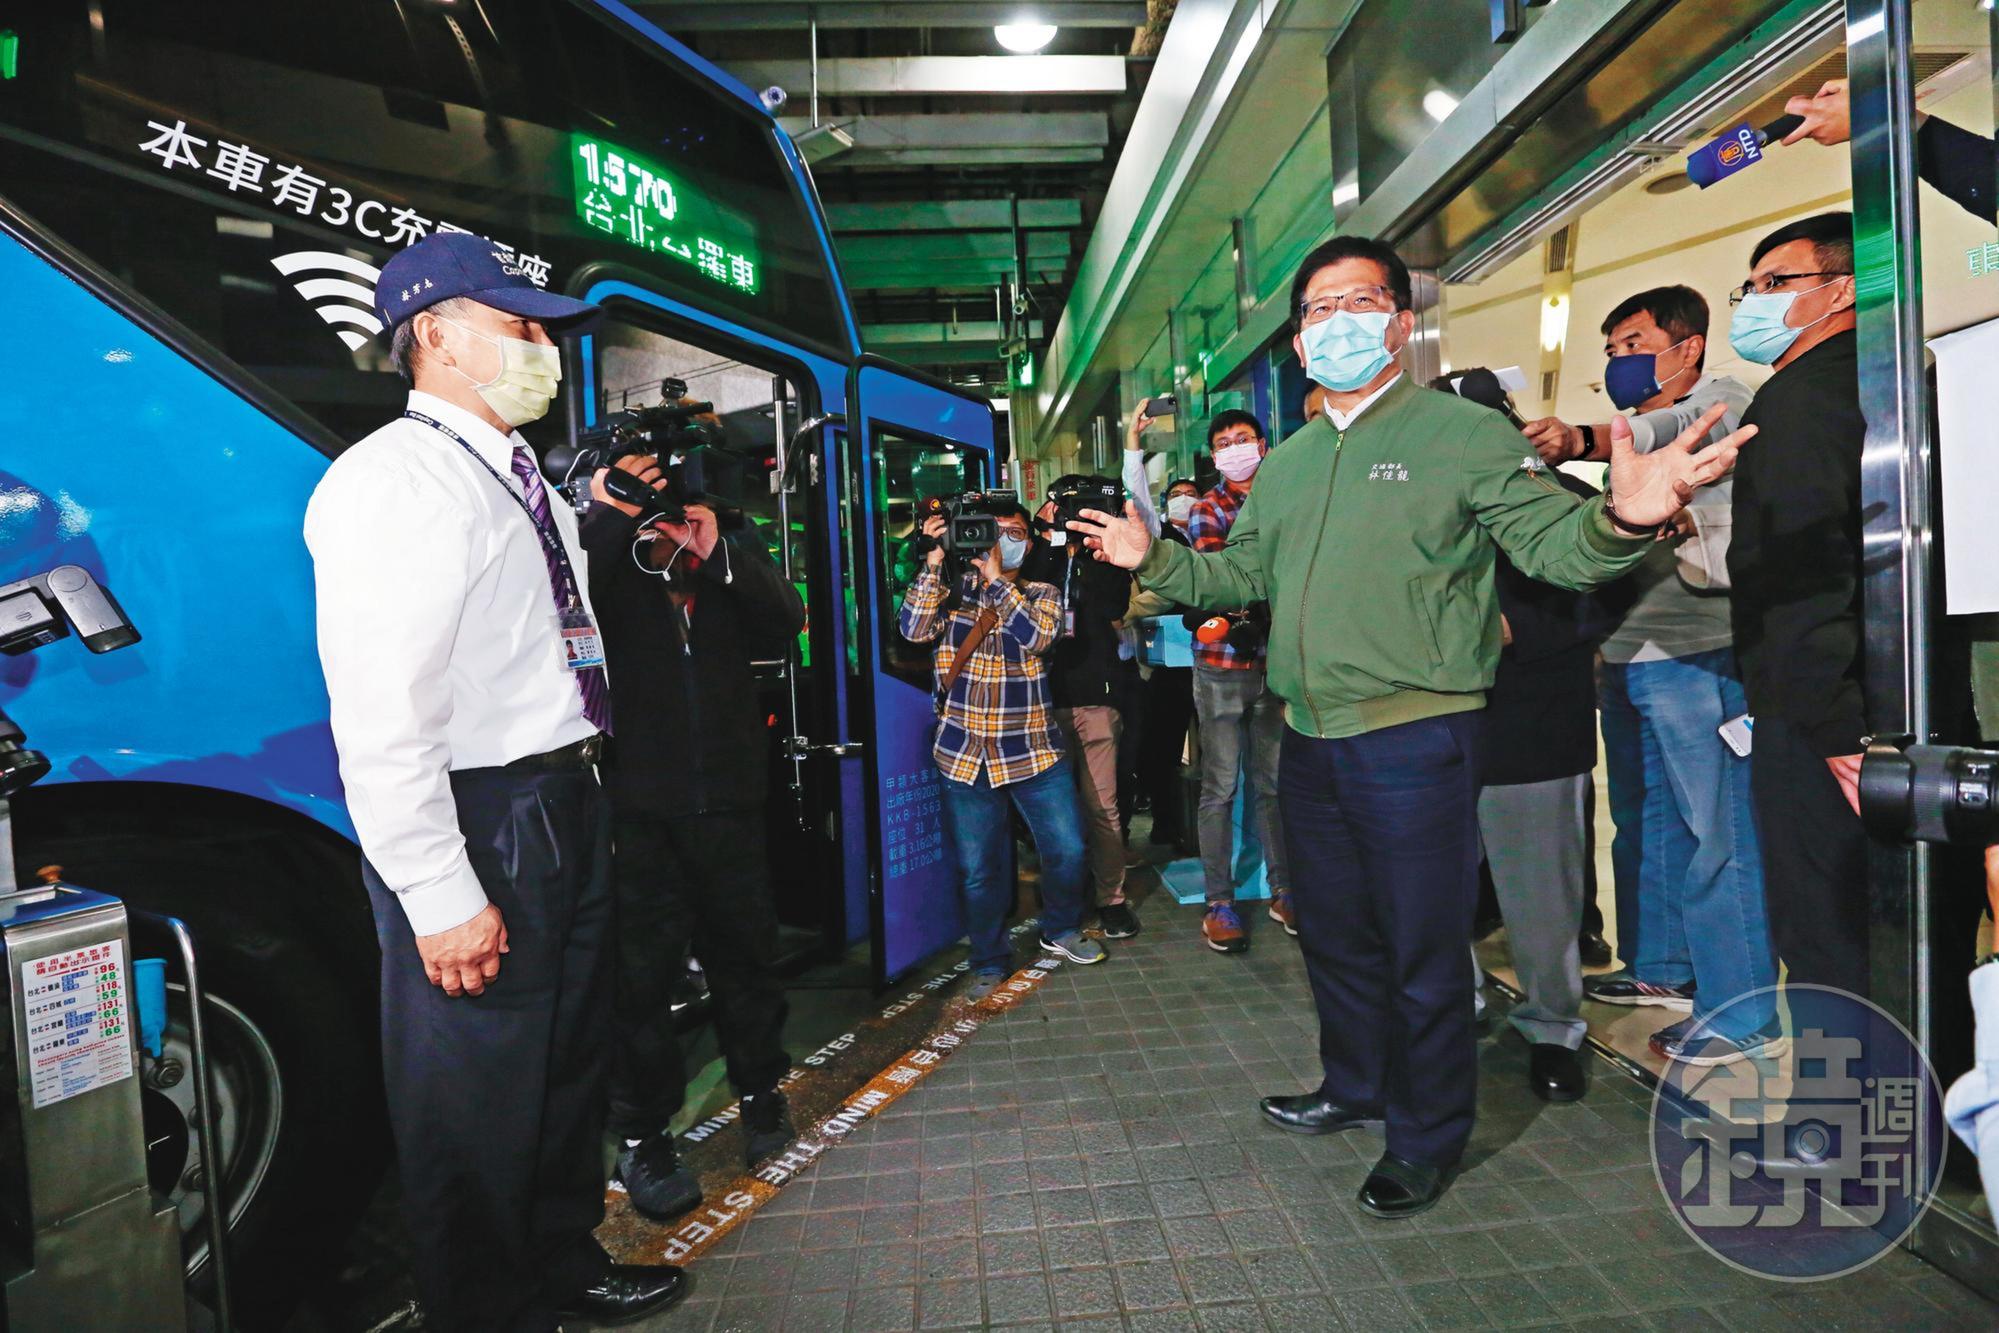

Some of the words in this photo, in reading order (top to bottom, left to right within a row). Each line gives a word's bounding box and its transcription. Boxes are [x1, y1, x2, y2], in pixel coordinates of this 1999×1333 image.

[1738, 129, 1759, 159] NTD
[579, 143, 678, 220] 1570
[138, 120, 552, 291] 本車有3C充座
[100, 963, 116, 974] 96
[101, 971, 116, 981] 48
[101, 980, 117, 991] 118
[102, 989, 118, 1000] 59
[102, 999, 118, 1010] 131
[103, 1007, 119, 1019] 66
[882, 992, 925, 1019] STEP
[104, 1017, 120, 1028] 131
[105, 1025, 120, 1037] 66
[804, 1033, 856, 1065] STEP
[822, 1089, 891, 1135] MIND
[756, 1142, 826, 1185] THE
[664, 1191, 755, 1260] STEP
